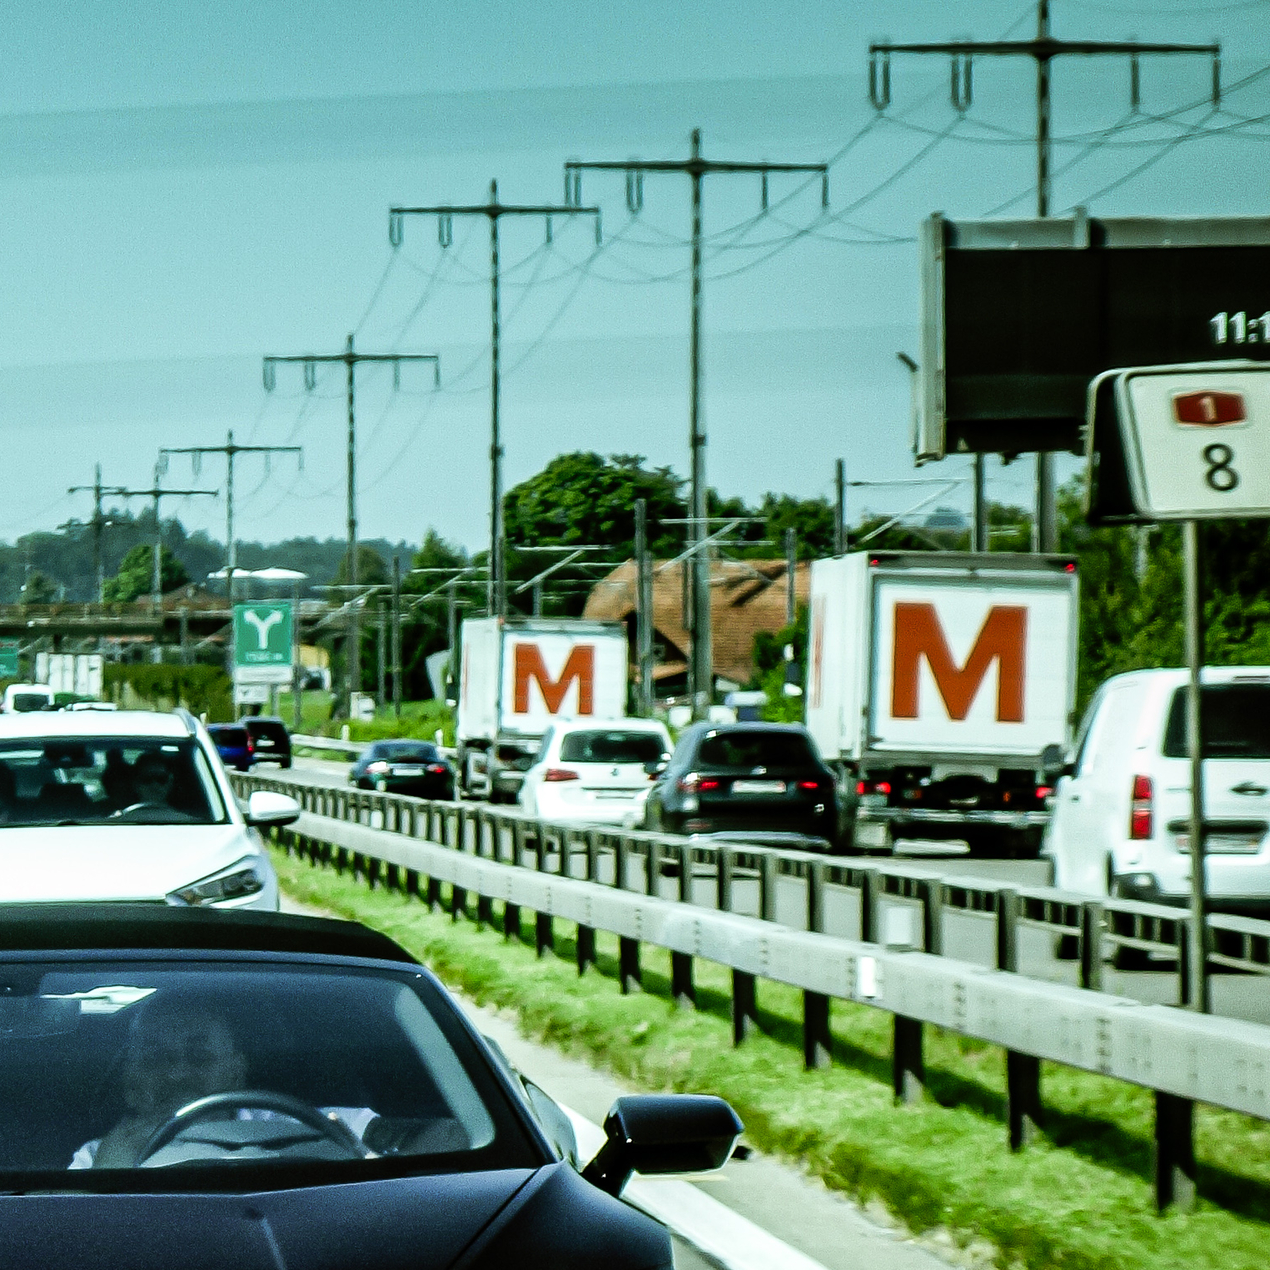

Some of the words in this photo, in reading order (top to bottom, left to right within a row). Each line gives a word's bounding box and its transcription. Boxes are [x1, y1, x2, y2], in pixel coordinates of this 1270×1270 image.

[1200, 396, 1217, 421] 1
[1203, 443, 1238, 491] 8
[514, 643, 595, 715] M
[891, 602, 1028, 722] M
